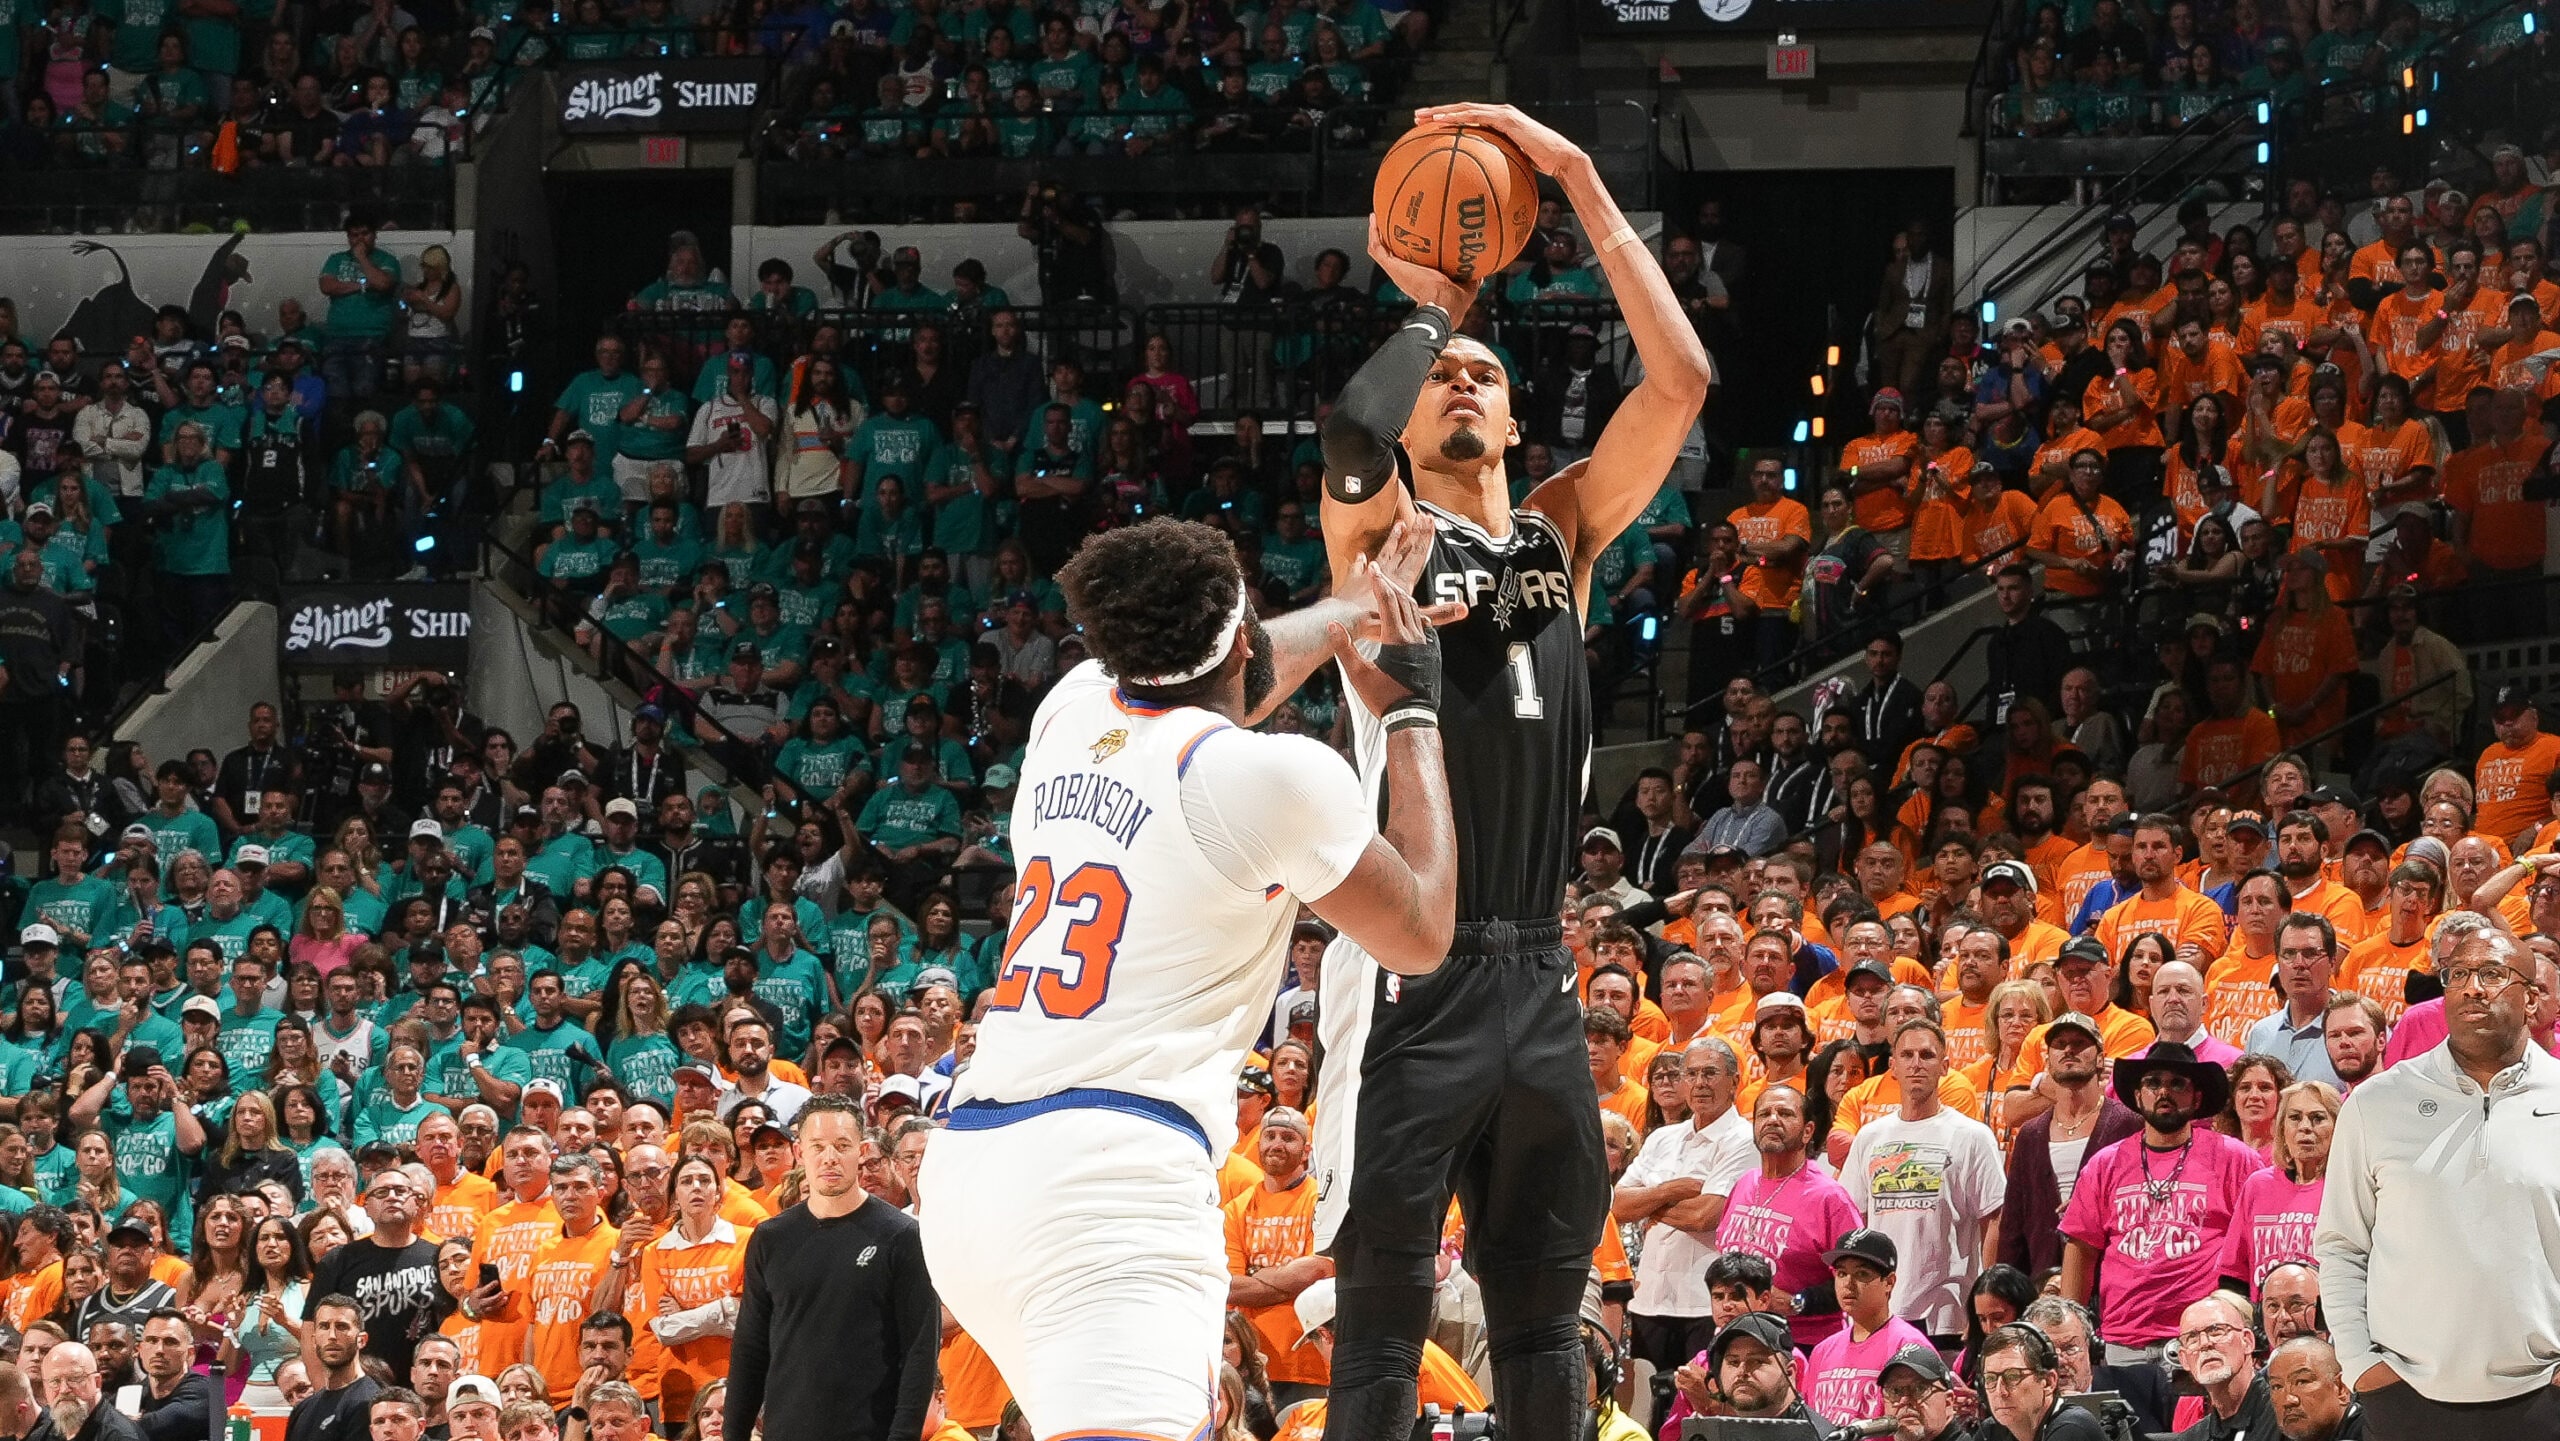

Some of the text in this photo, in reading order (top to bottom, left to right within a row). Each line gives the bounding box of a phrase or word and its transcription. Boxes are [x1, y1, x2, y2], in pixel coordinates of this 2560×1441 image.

[1777, 49, 1806, 73] EXIT
[565, 71, 663, 120] Shiner
[648, 138, 679, 164] EXIT
[1457, 193, 1487, 281] Wilso
[286, 597, 394, 651] Shiner
[1506, 641, 1544, 719] 1
[1034, 773, 1153, 851] ROBINSON
[990, 856, 1132, 1019] 23
[1953, 1028, 1977, 1038] 2026
[2113, 1194, 2208, 1234] FINALS
[2278, 1212, 2315, 1225] 2026
[2117, 1225, 2202, 1262] GO GO
[356, 1273, 383, 1299] SAN
[532, 1269, 592, 1303] FINALS
[675, 1268, 705, 1278] 2026
[361, 1287, 437, 1322] SPURS
[557, 1295, 584, 1324] GO
[1831, 1368, 1858, 1380] 2026
[1814, 1379, 1880, 1418] FINALS
